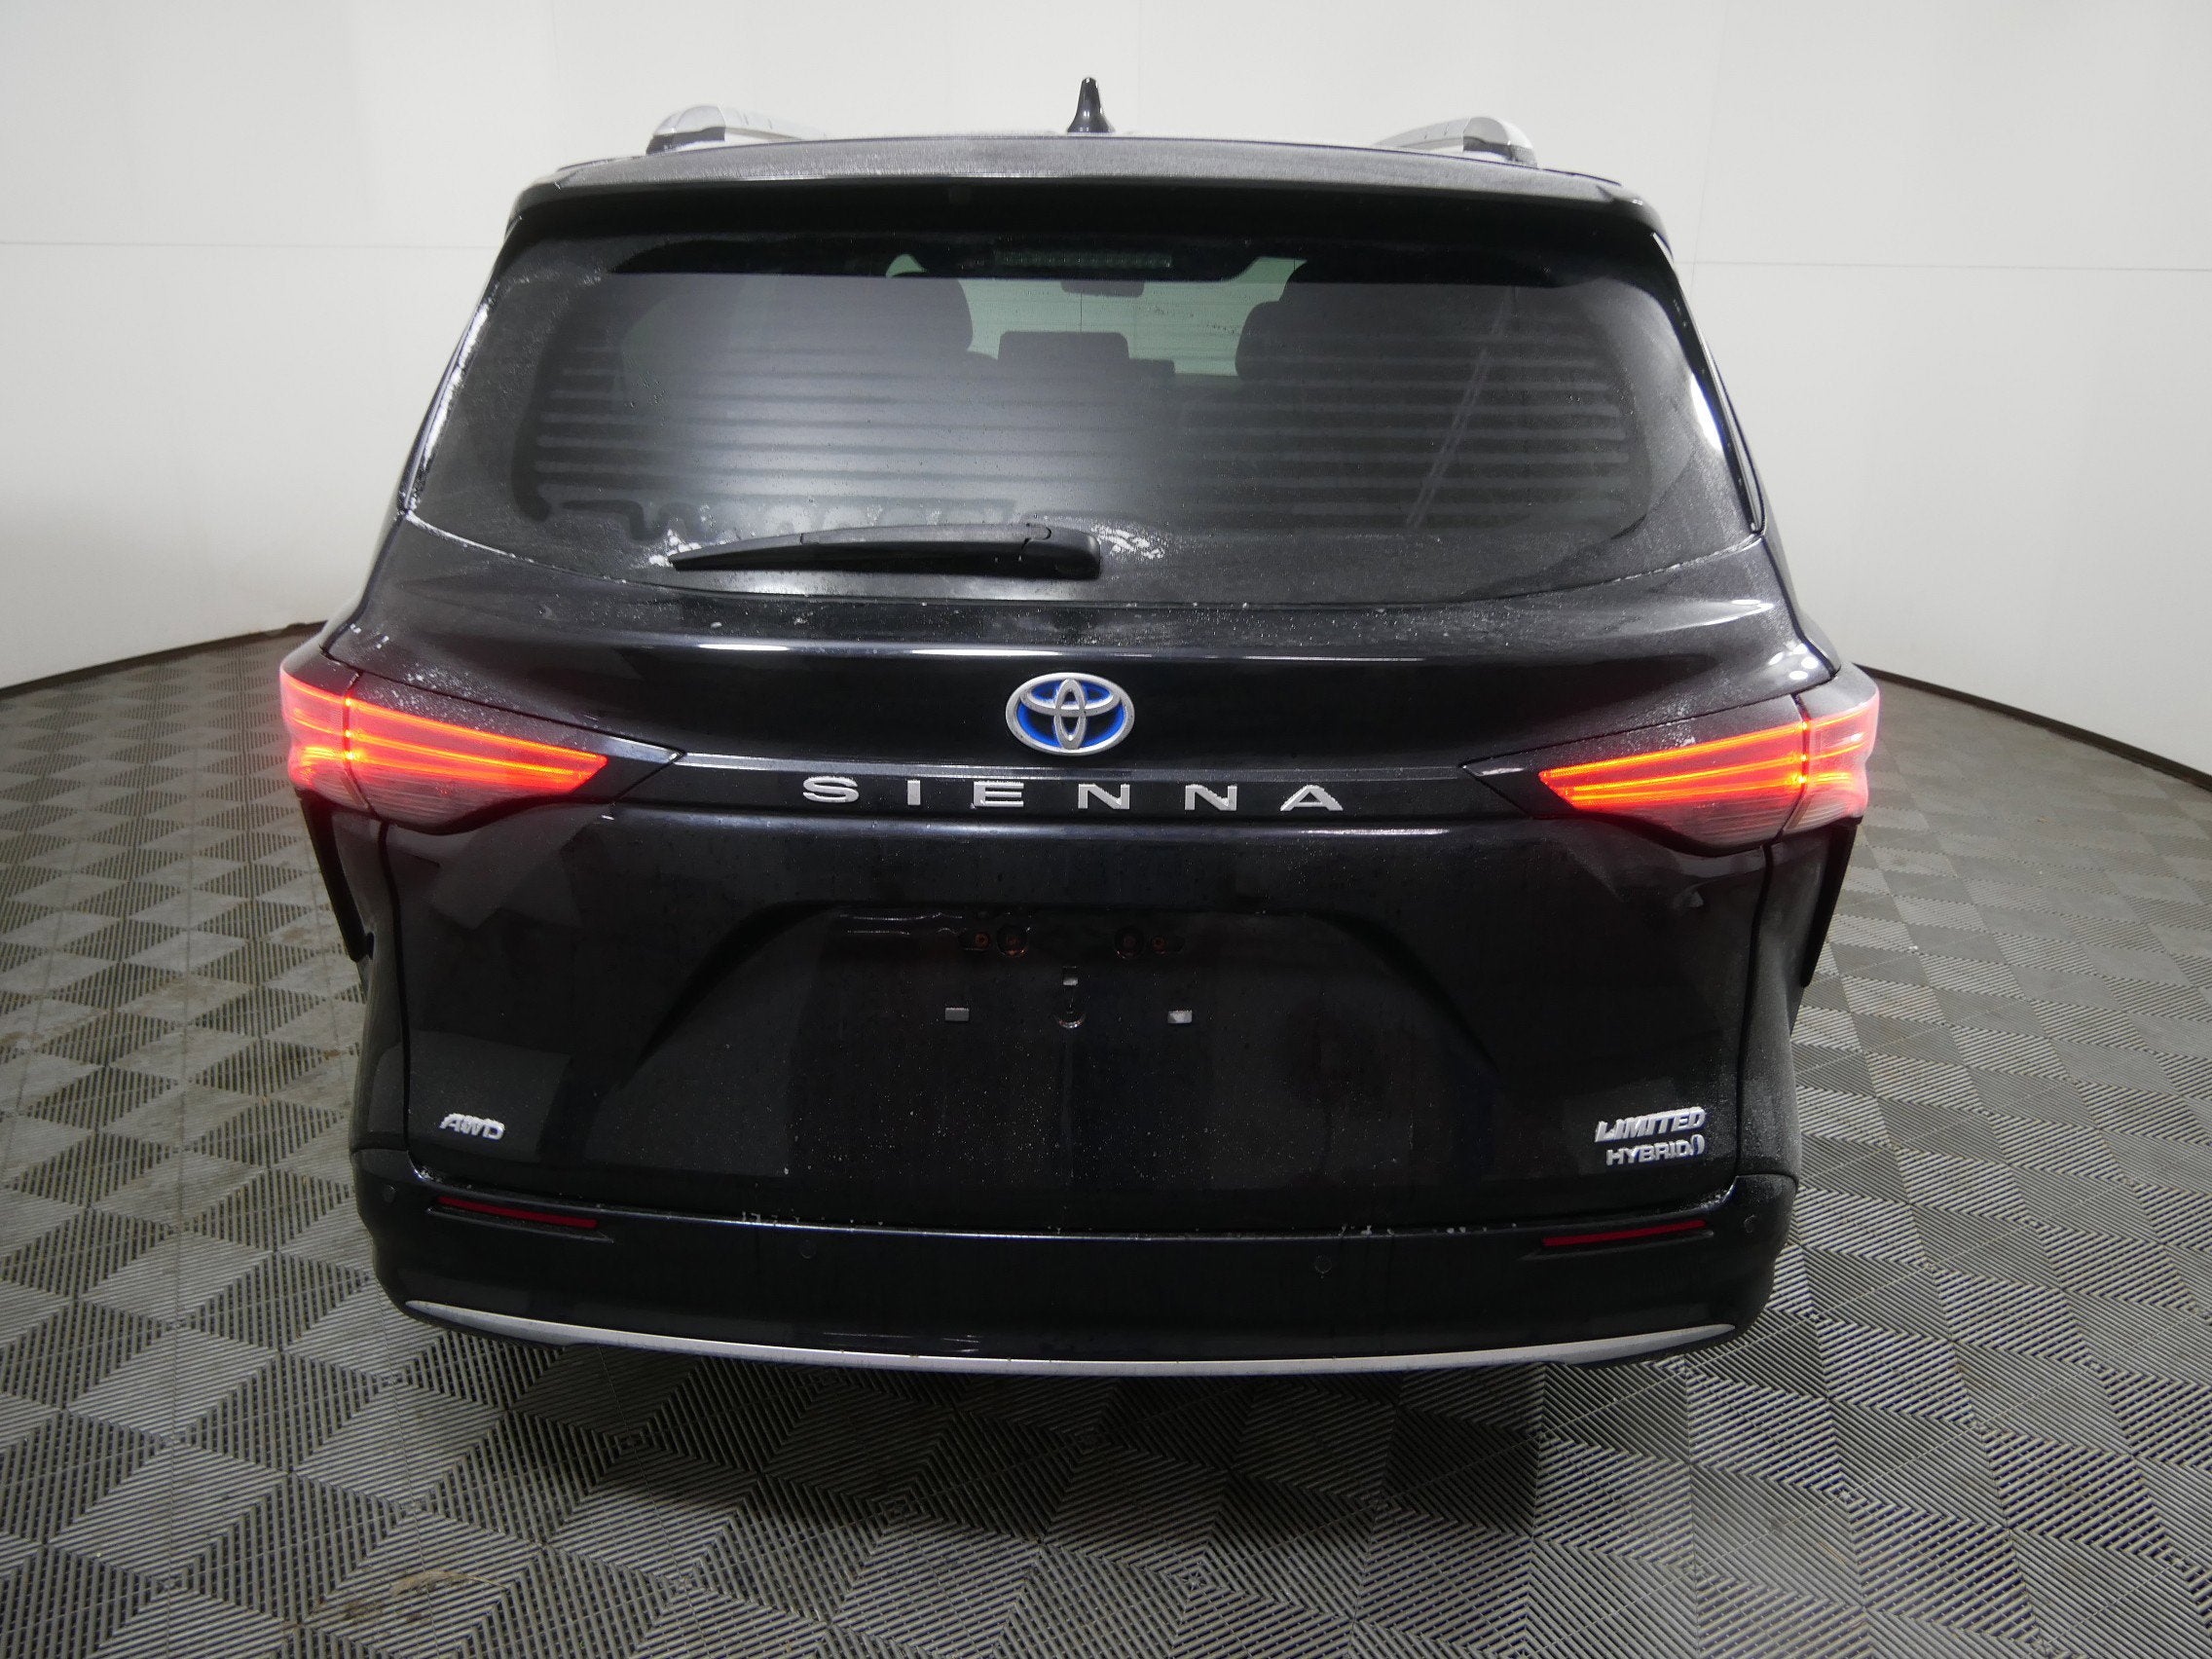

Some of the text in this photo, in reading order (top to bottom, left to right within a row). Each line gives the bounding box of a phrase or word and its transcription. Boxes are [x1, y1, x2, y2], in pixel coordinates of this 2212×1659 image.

[802, 776, 1344, 812] SIENNA
[439, 1113, 505, 1140] AWD
[1595, 1106, 1705, 1142] LIMITED
[1606, 1139, 1692, 1166] HYBRID
